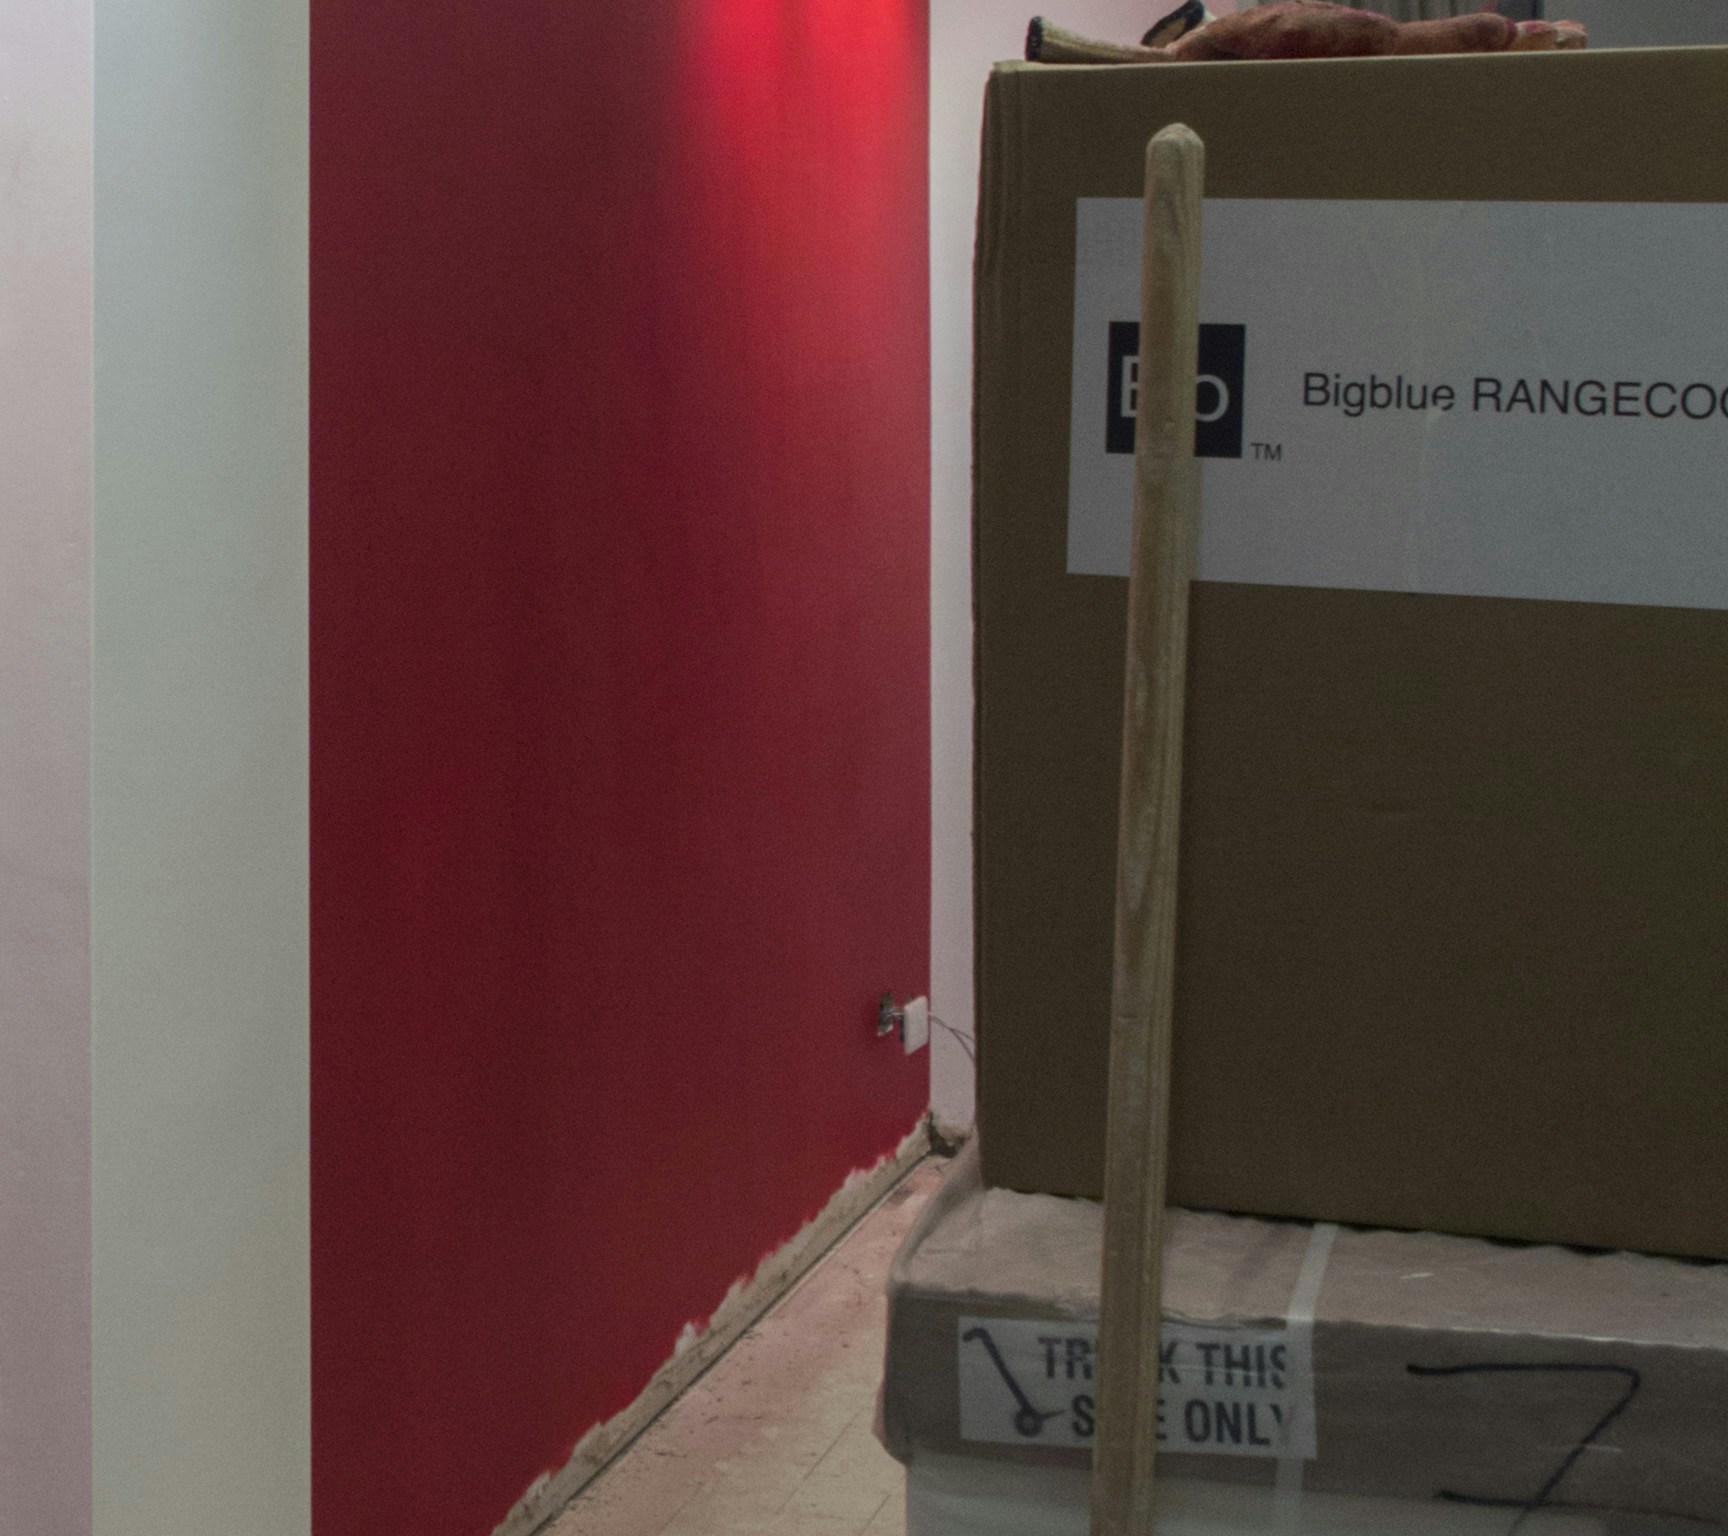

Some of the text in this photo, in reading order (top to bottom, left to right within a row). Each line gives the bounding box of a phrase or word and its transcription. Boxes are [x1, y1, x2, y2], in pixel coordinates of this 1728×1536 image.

[1302, 372, 1728, 420] Bigblue RANGECO
[1037, 1335, 1286, 1389] TRK THIS
[1071, 1394, 1167, 1441] SE
